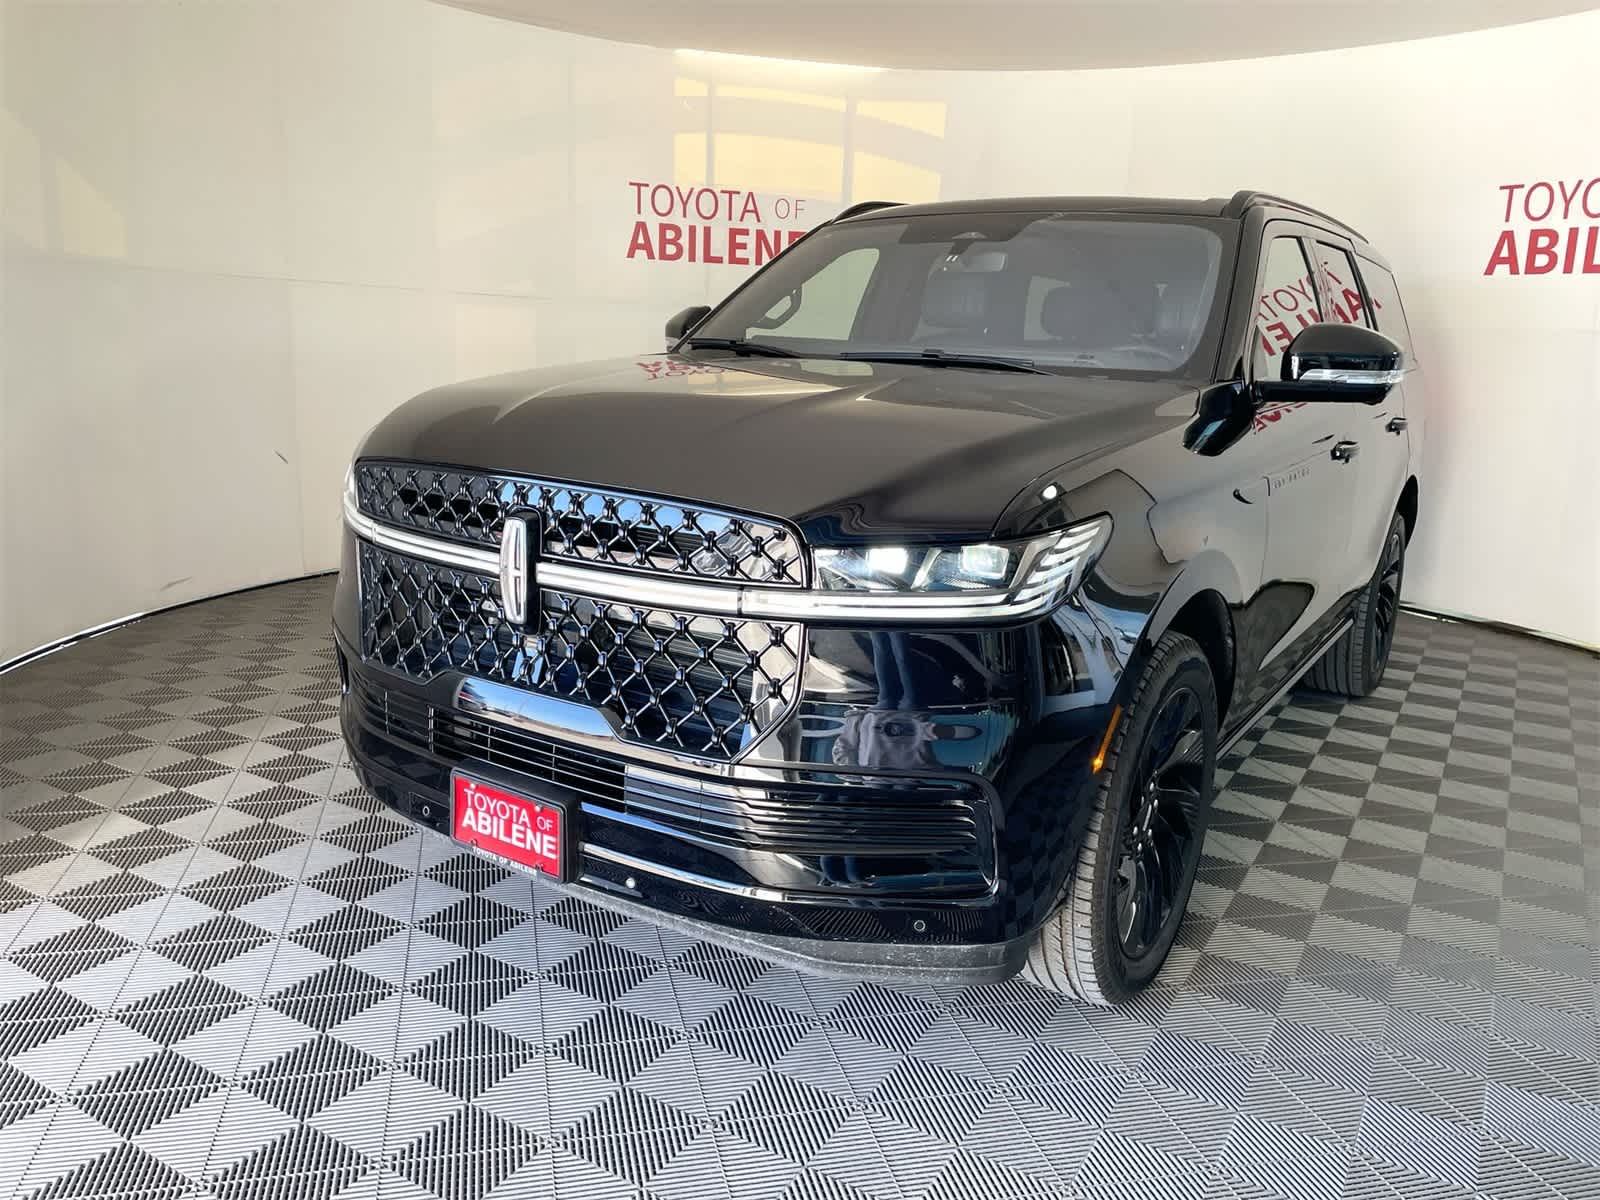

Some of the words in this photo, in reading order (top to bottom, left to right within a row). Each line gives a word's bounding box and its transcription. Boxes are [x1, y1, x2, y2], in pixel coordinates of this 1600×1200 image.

[628, 181, 761, 223] TOYOTA
[775, 198, 806, 220] OF
[463, 788, 532, 828] TOYOTA
[536, 816, 553, 831] OF
[462, 807, 557, 859] ABILENE
[472, 846, 497, 861] TOYOTA
